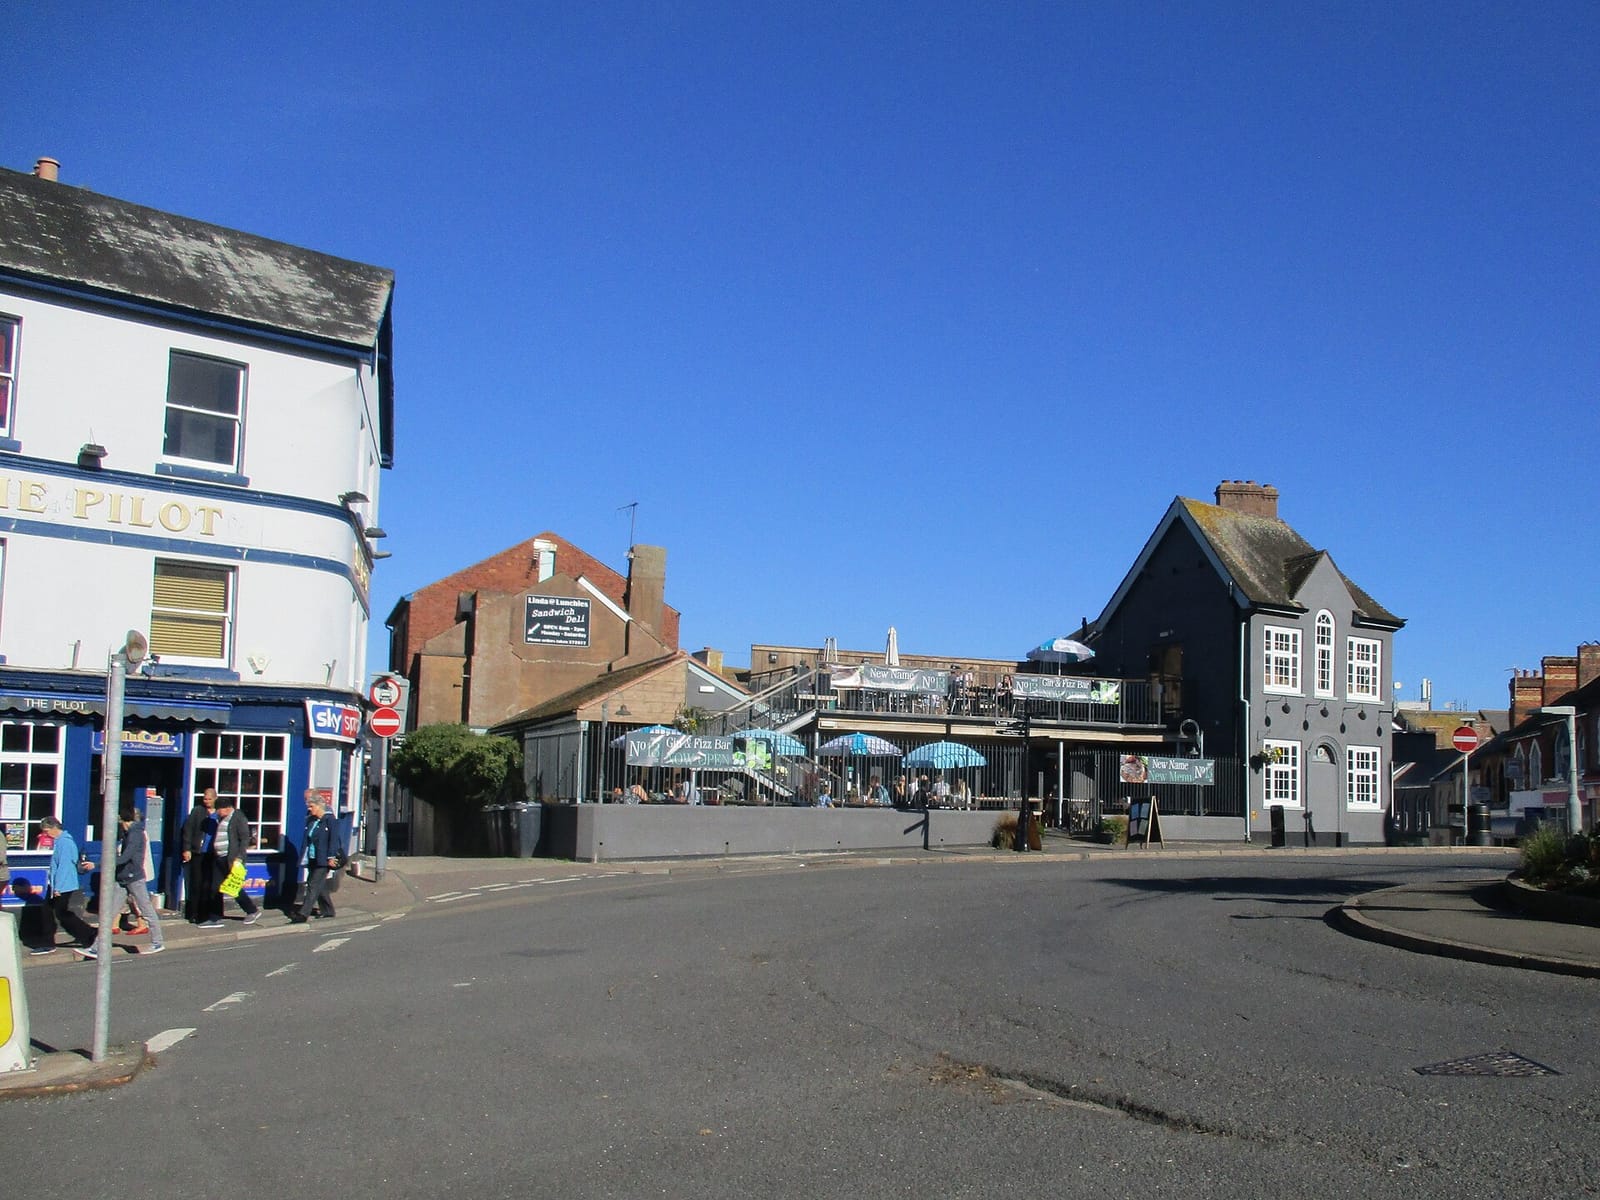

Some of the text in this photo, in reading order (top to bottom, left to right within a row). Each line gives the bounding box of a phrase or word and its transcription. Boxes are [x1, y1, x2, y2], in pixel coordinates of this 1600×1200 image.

[73, 488, 224, 536] PILOT
[528, 597, 548, 605] Linda
[531, 608, 575, 617] Sandwich
[565, 615, 585, 623] Deli
[870, 668, 914, 680] New Name
[1041, 679, 1089, 689] Gin & Fizz Bar
[24, 698, 48, 709] THE
[316, 708, 342, 733] sky
[685, 739, 693, 749] &
[694, 738, 712, 750] Fizz
[714, 738, 731, 750] Bar
[1152, 759, 1189, 770] New Name
[1149, 770, 1192, 782] New Menu
